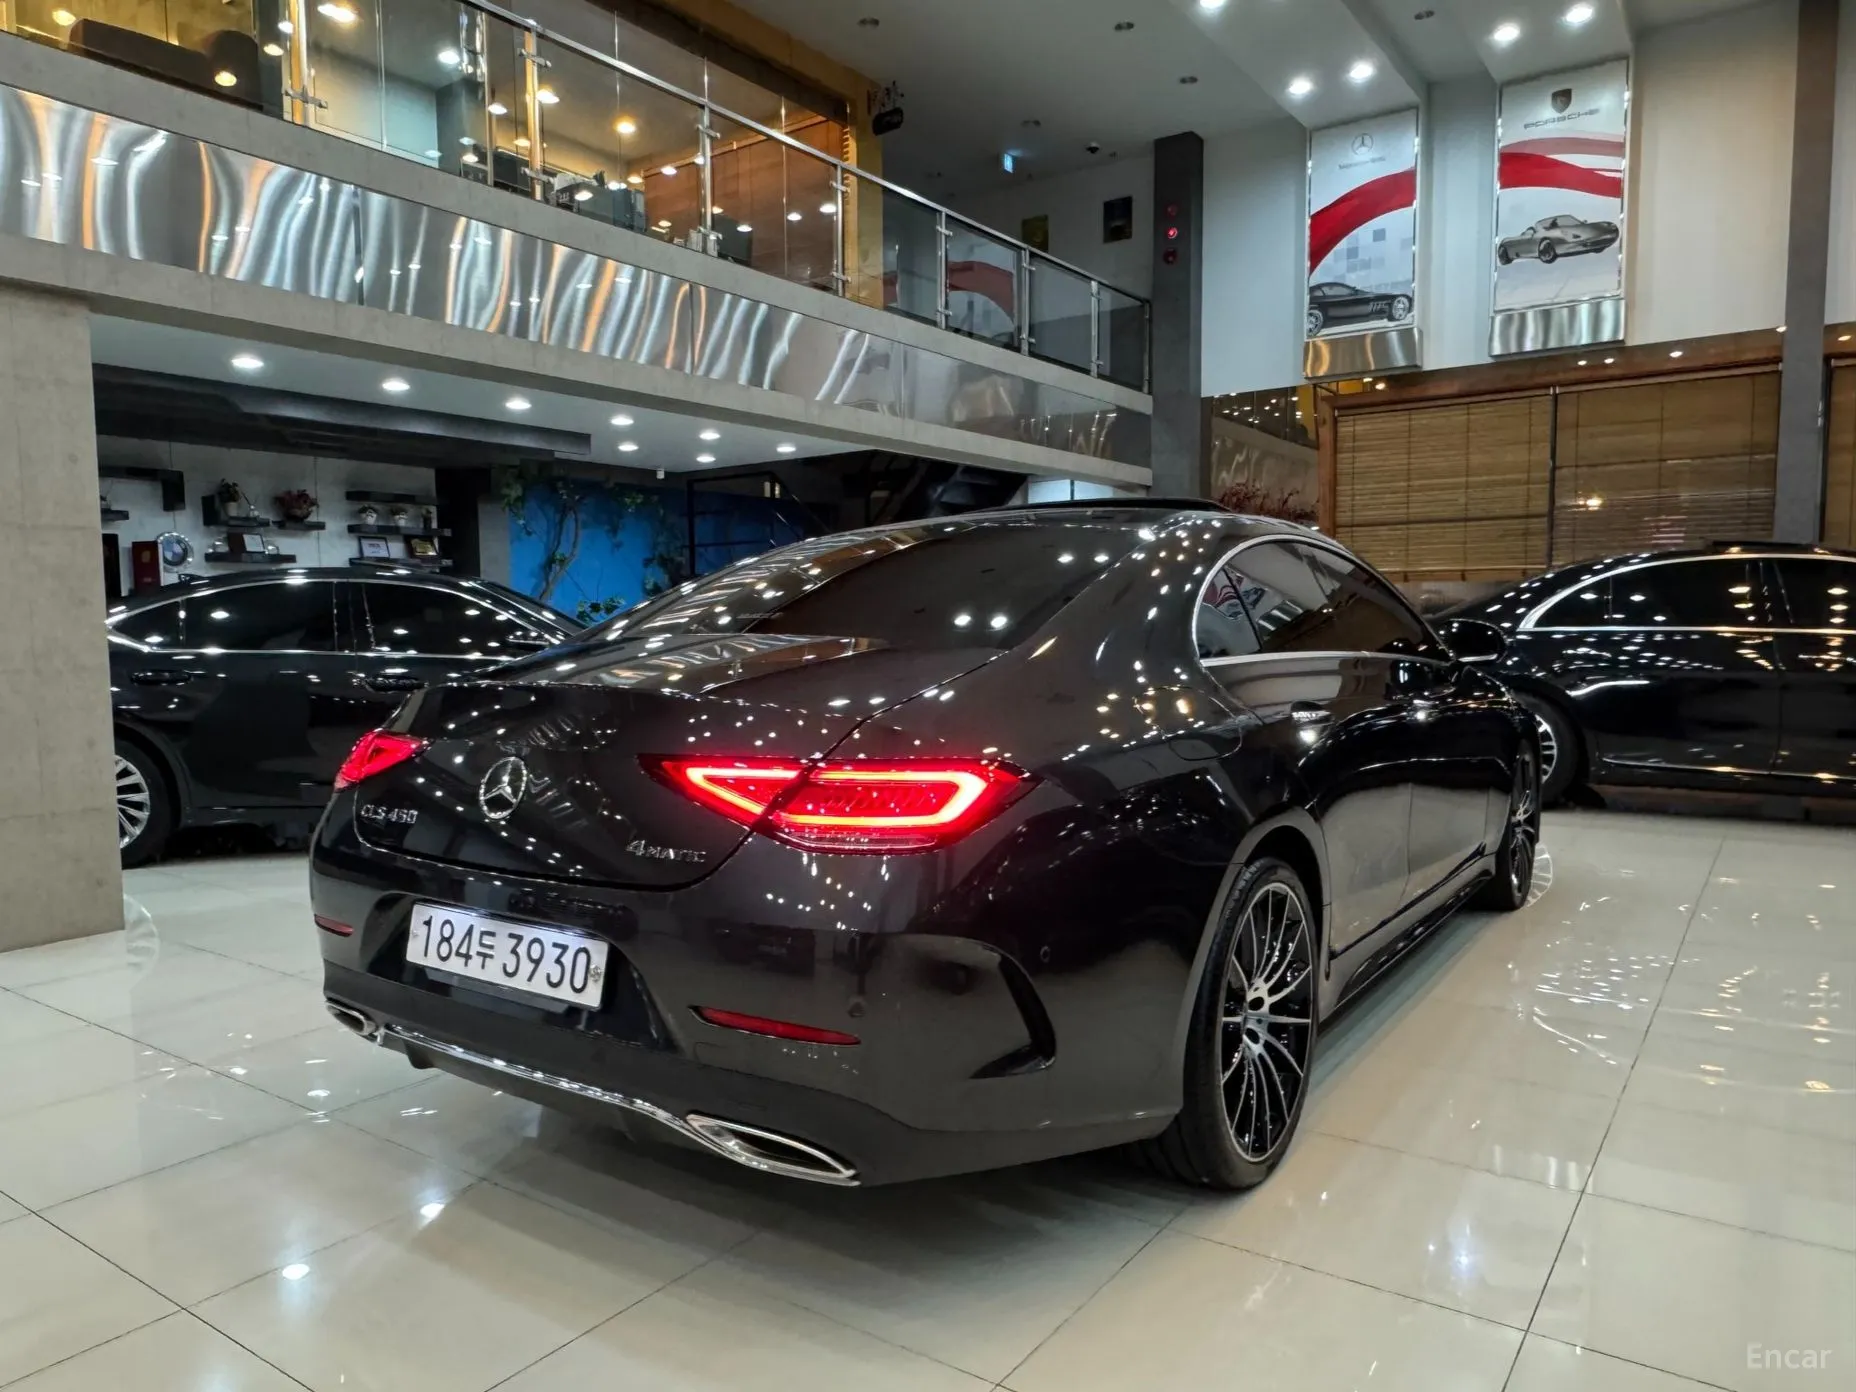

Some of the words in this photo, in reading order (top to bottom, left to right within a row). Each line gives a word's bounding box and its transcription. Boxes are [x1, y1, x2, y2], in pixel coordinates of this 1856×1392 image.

[1523, 108, 1600, 130] PORSCHE
[361, 804, 387, 819] CLS
[388, 808, 418, 823] 450
[626, 839, 706, 862] 4MATIC
